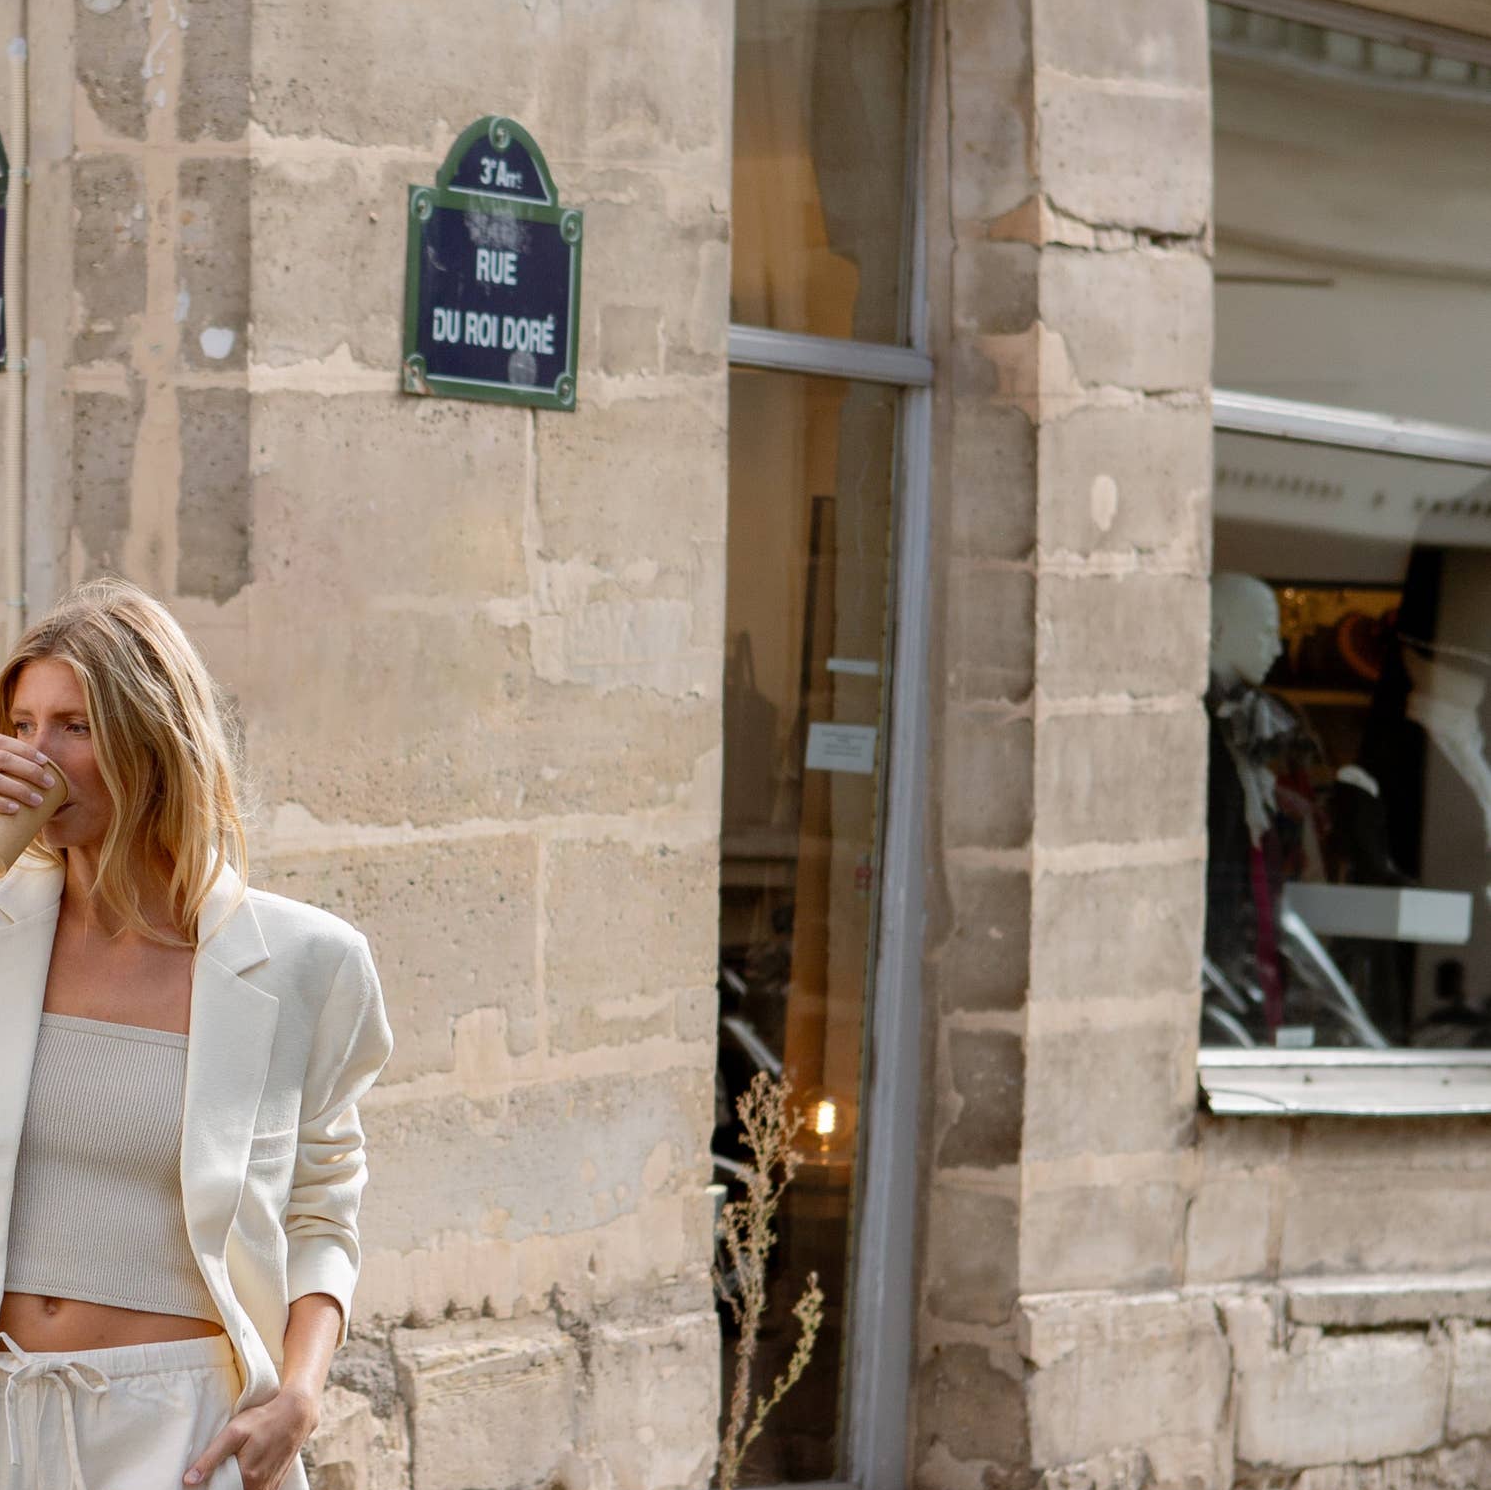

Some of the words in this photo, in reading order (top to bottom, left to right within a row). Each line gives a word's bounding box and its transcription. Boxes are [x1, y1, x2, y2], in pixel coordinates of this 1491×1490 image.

[476, 248, 518, 286] RUE
[432, 307, 460, 344] DU
[464, 311, 498, 349] ROI
[501, 313, 556, 356] DORÉ
